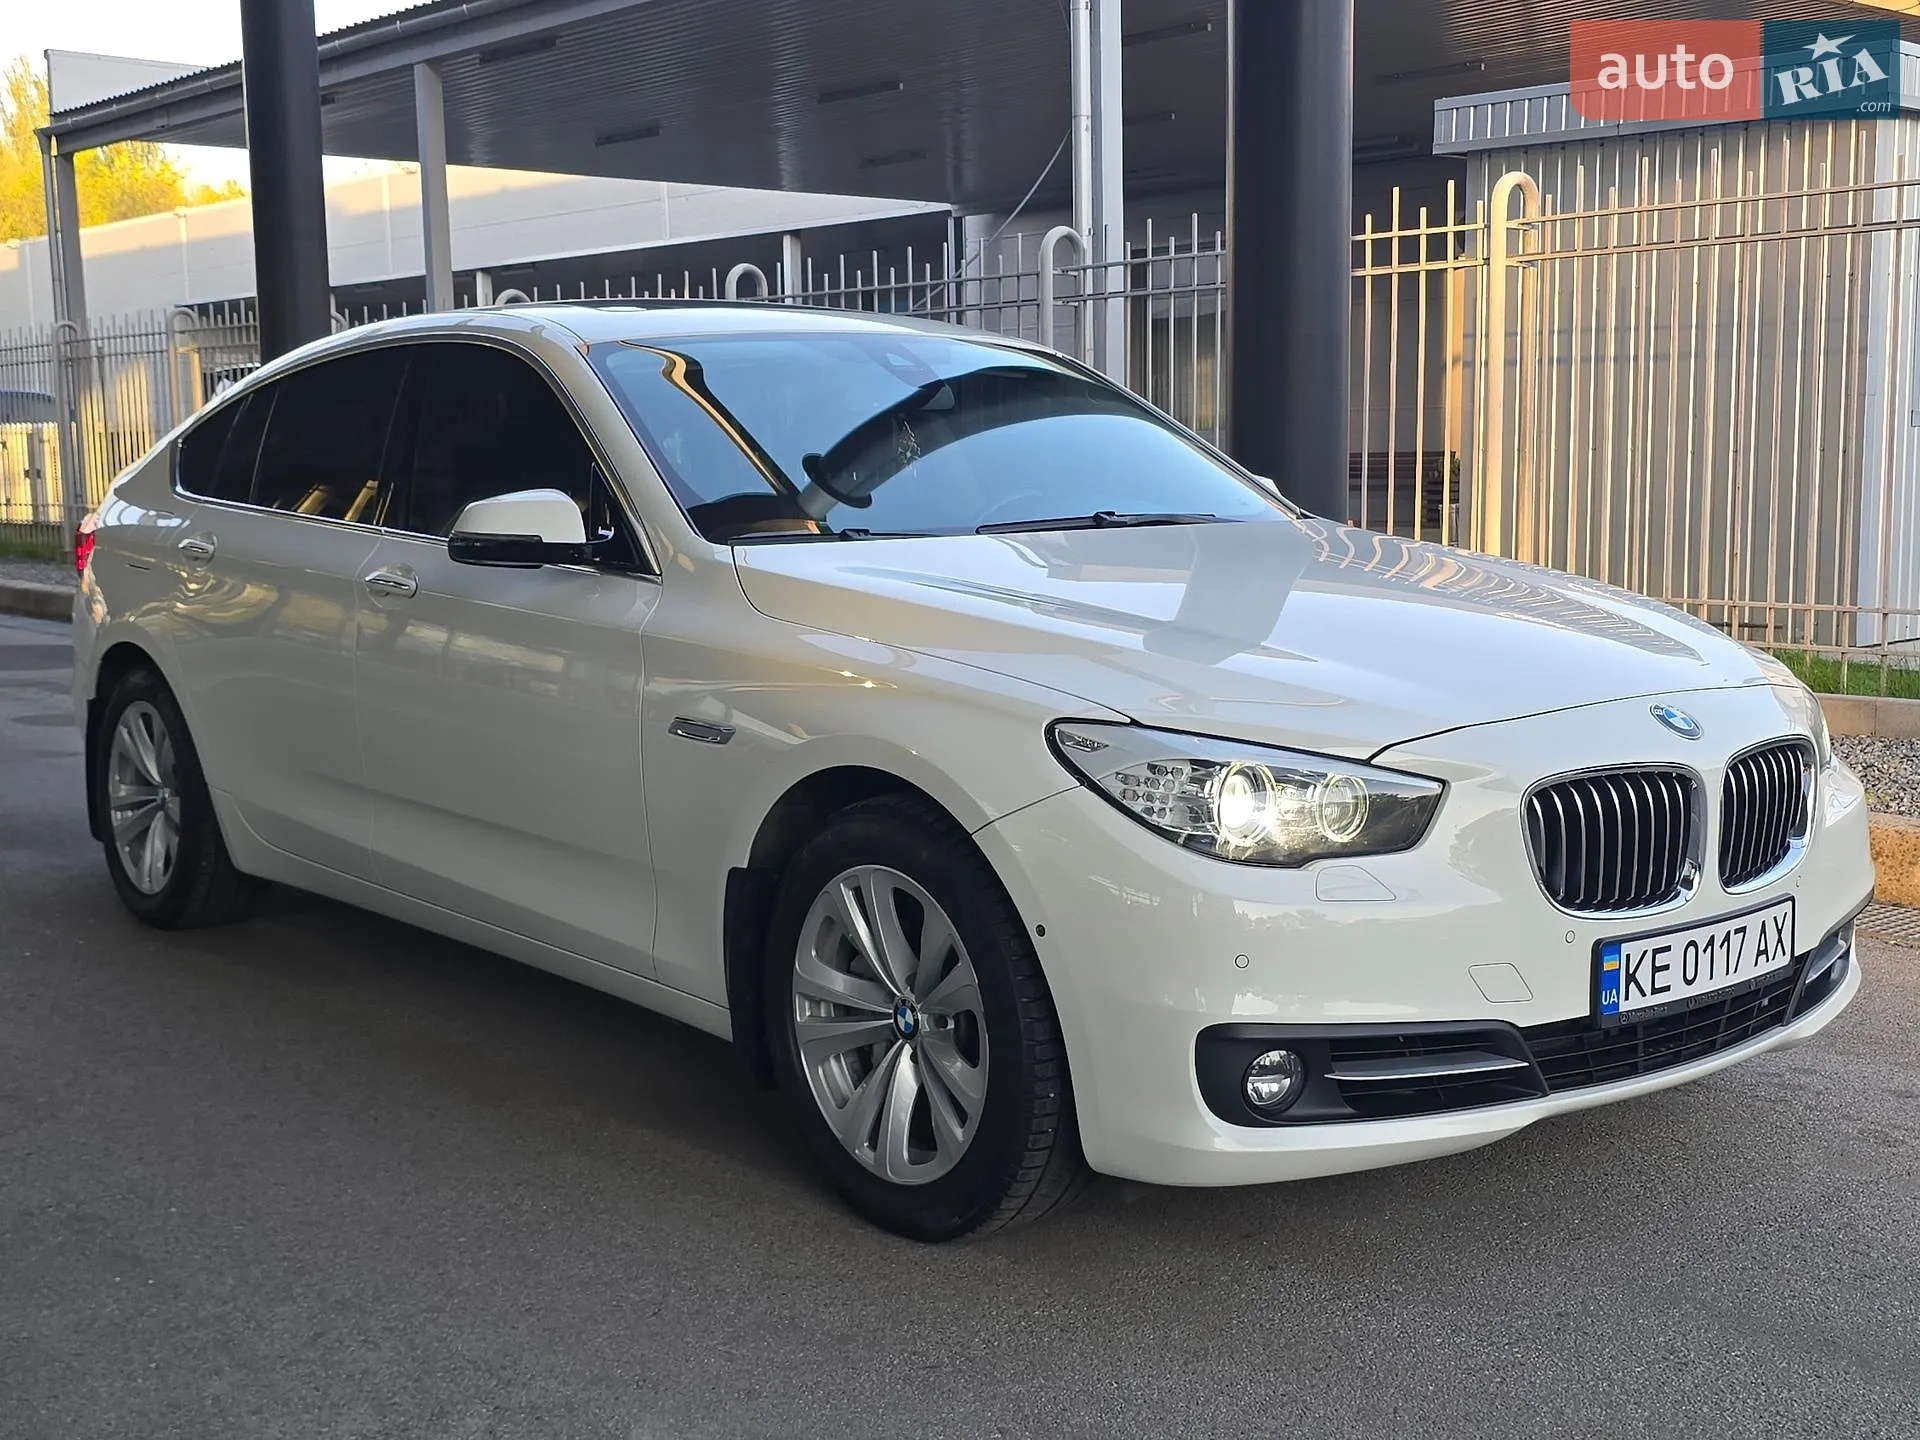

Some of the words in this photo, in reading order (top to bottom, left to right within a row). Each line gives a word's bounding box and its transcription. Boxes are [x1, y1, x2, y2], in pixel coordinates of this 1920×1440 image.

[1623, 944, 1672, 1002] KE
[1682, 925, 1748, 986] 0117
[1753, 911, 1788, 968] AX
[1601, 987, 1619, 1006] UA
